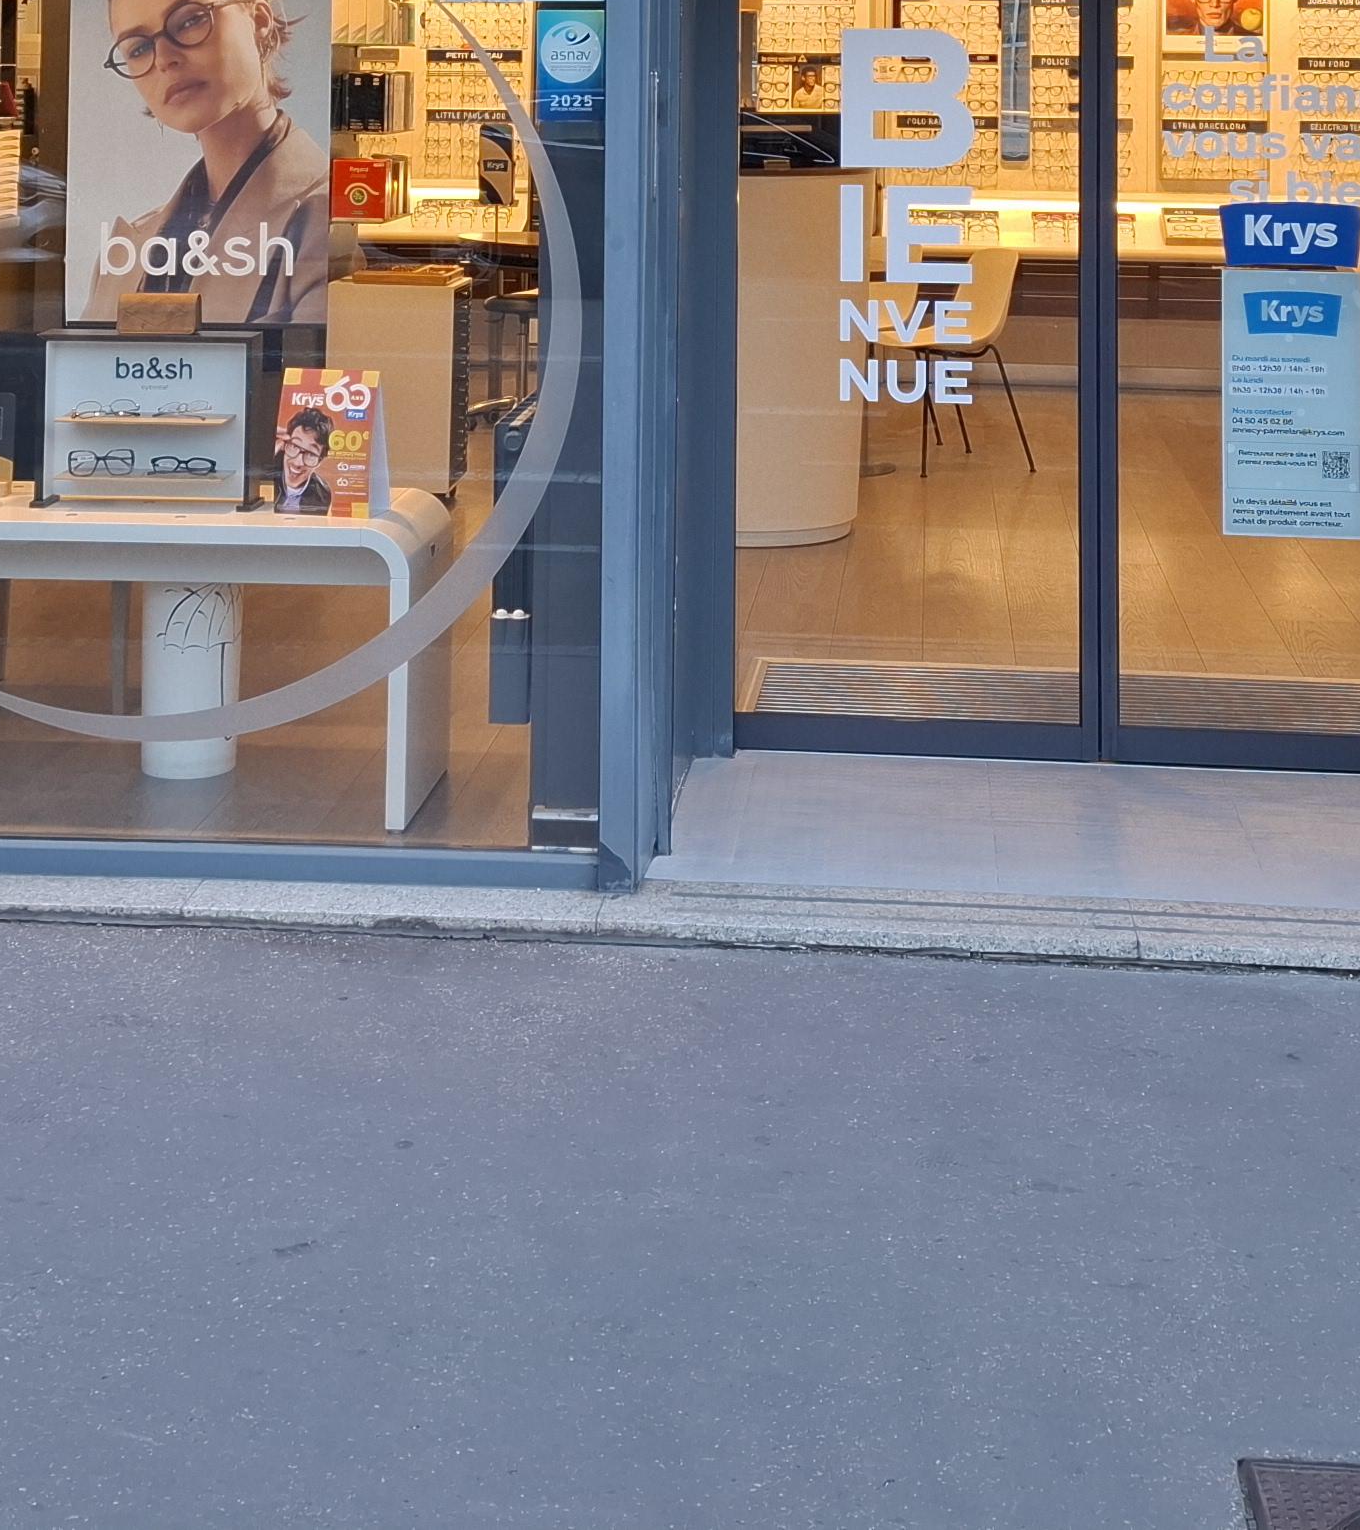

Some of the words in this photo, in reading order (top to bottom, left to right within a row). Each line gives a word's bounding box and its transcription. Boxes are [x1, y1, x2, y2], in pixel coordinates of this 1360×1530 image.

[1203, 25, 1267, 63] La
[550, 50, 591, 61] asnav
[1041, 58, 1070, 66] POLICE
[550, 95, 593, 107] 2025
[435, 111, 460, 119] LITTLE
[1162, 130, 1287, 161] vous
[1228, 169, 1268, 204] si
[1243, 214, 1340, 255] Krys
[98, 221, 296, 278] ba&sh
[1259, 298, 1326, 327] Krys
[115, 356, 194, 380] ba&sh
[291, 393, 324, 408] Krys
[1257, 509, 1309, 517] gratuitement
[1269, 519, 1297, 527] produit
